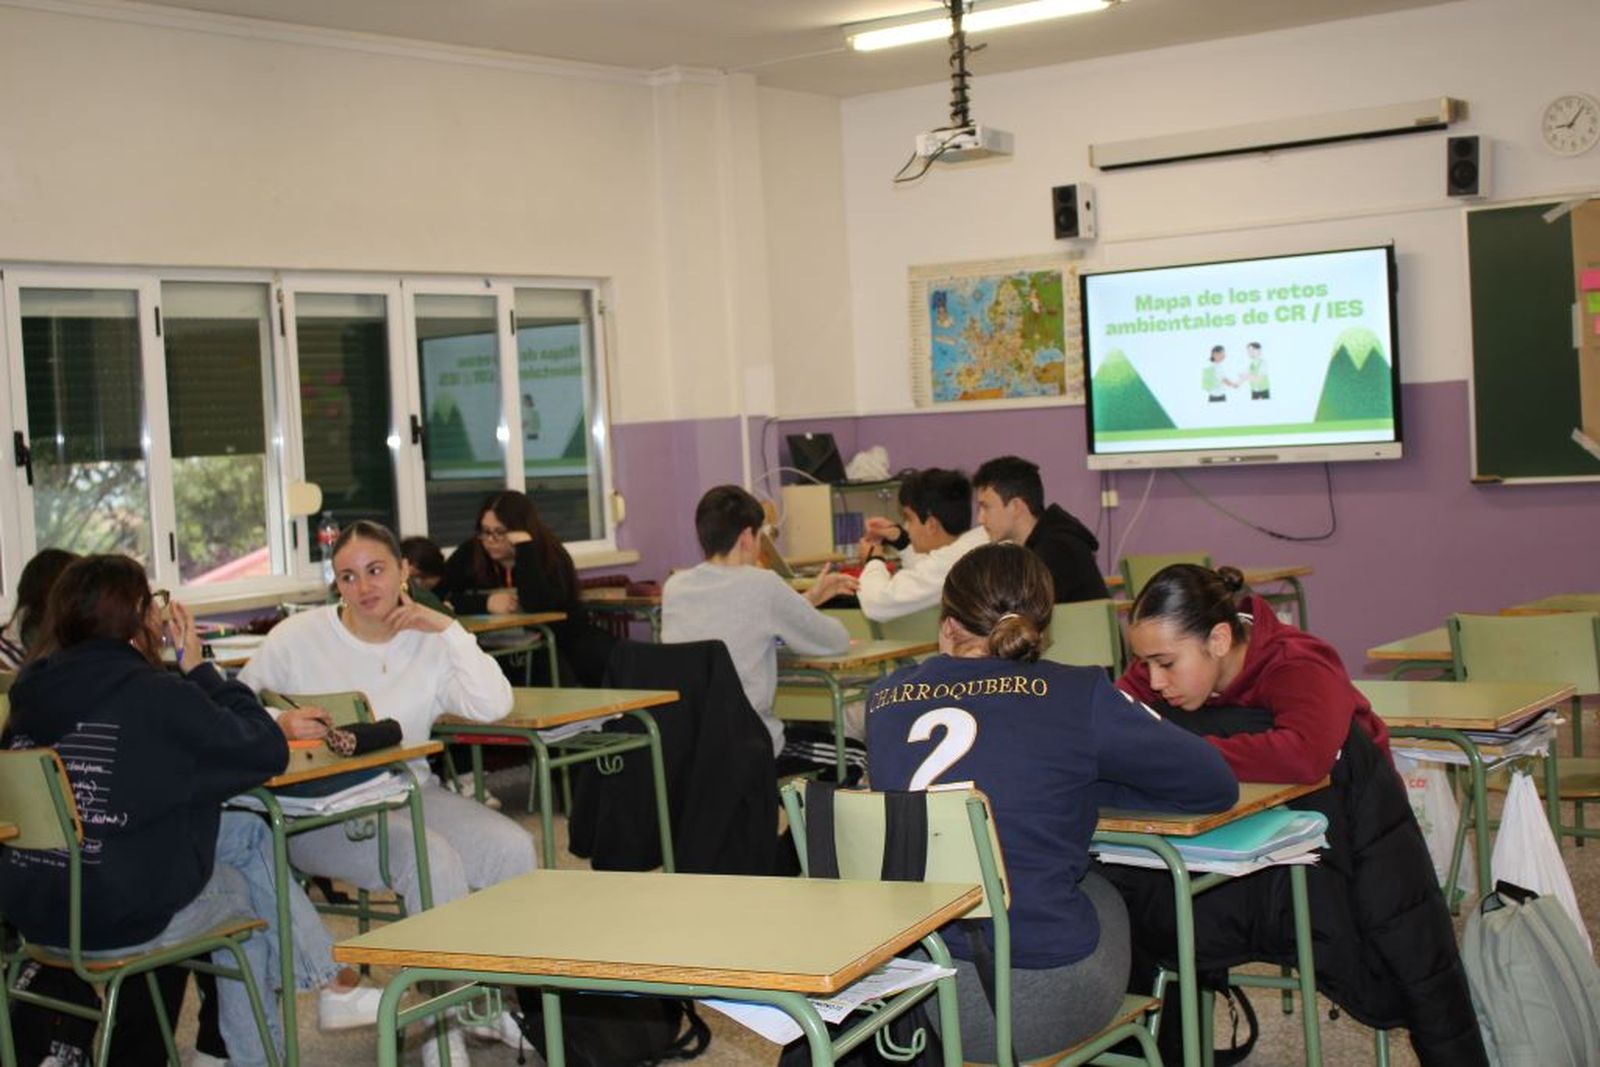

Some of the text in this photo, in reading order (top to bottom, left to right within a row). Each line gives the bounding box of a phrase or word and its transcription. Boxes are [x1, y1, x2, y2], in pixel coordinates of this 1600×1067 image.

[1135, 283, 1328, 312] Mapa de los retos
[1105, 299, 1364, 335] ambientales de CR / IES
[907, 707, 977, 791] 2
